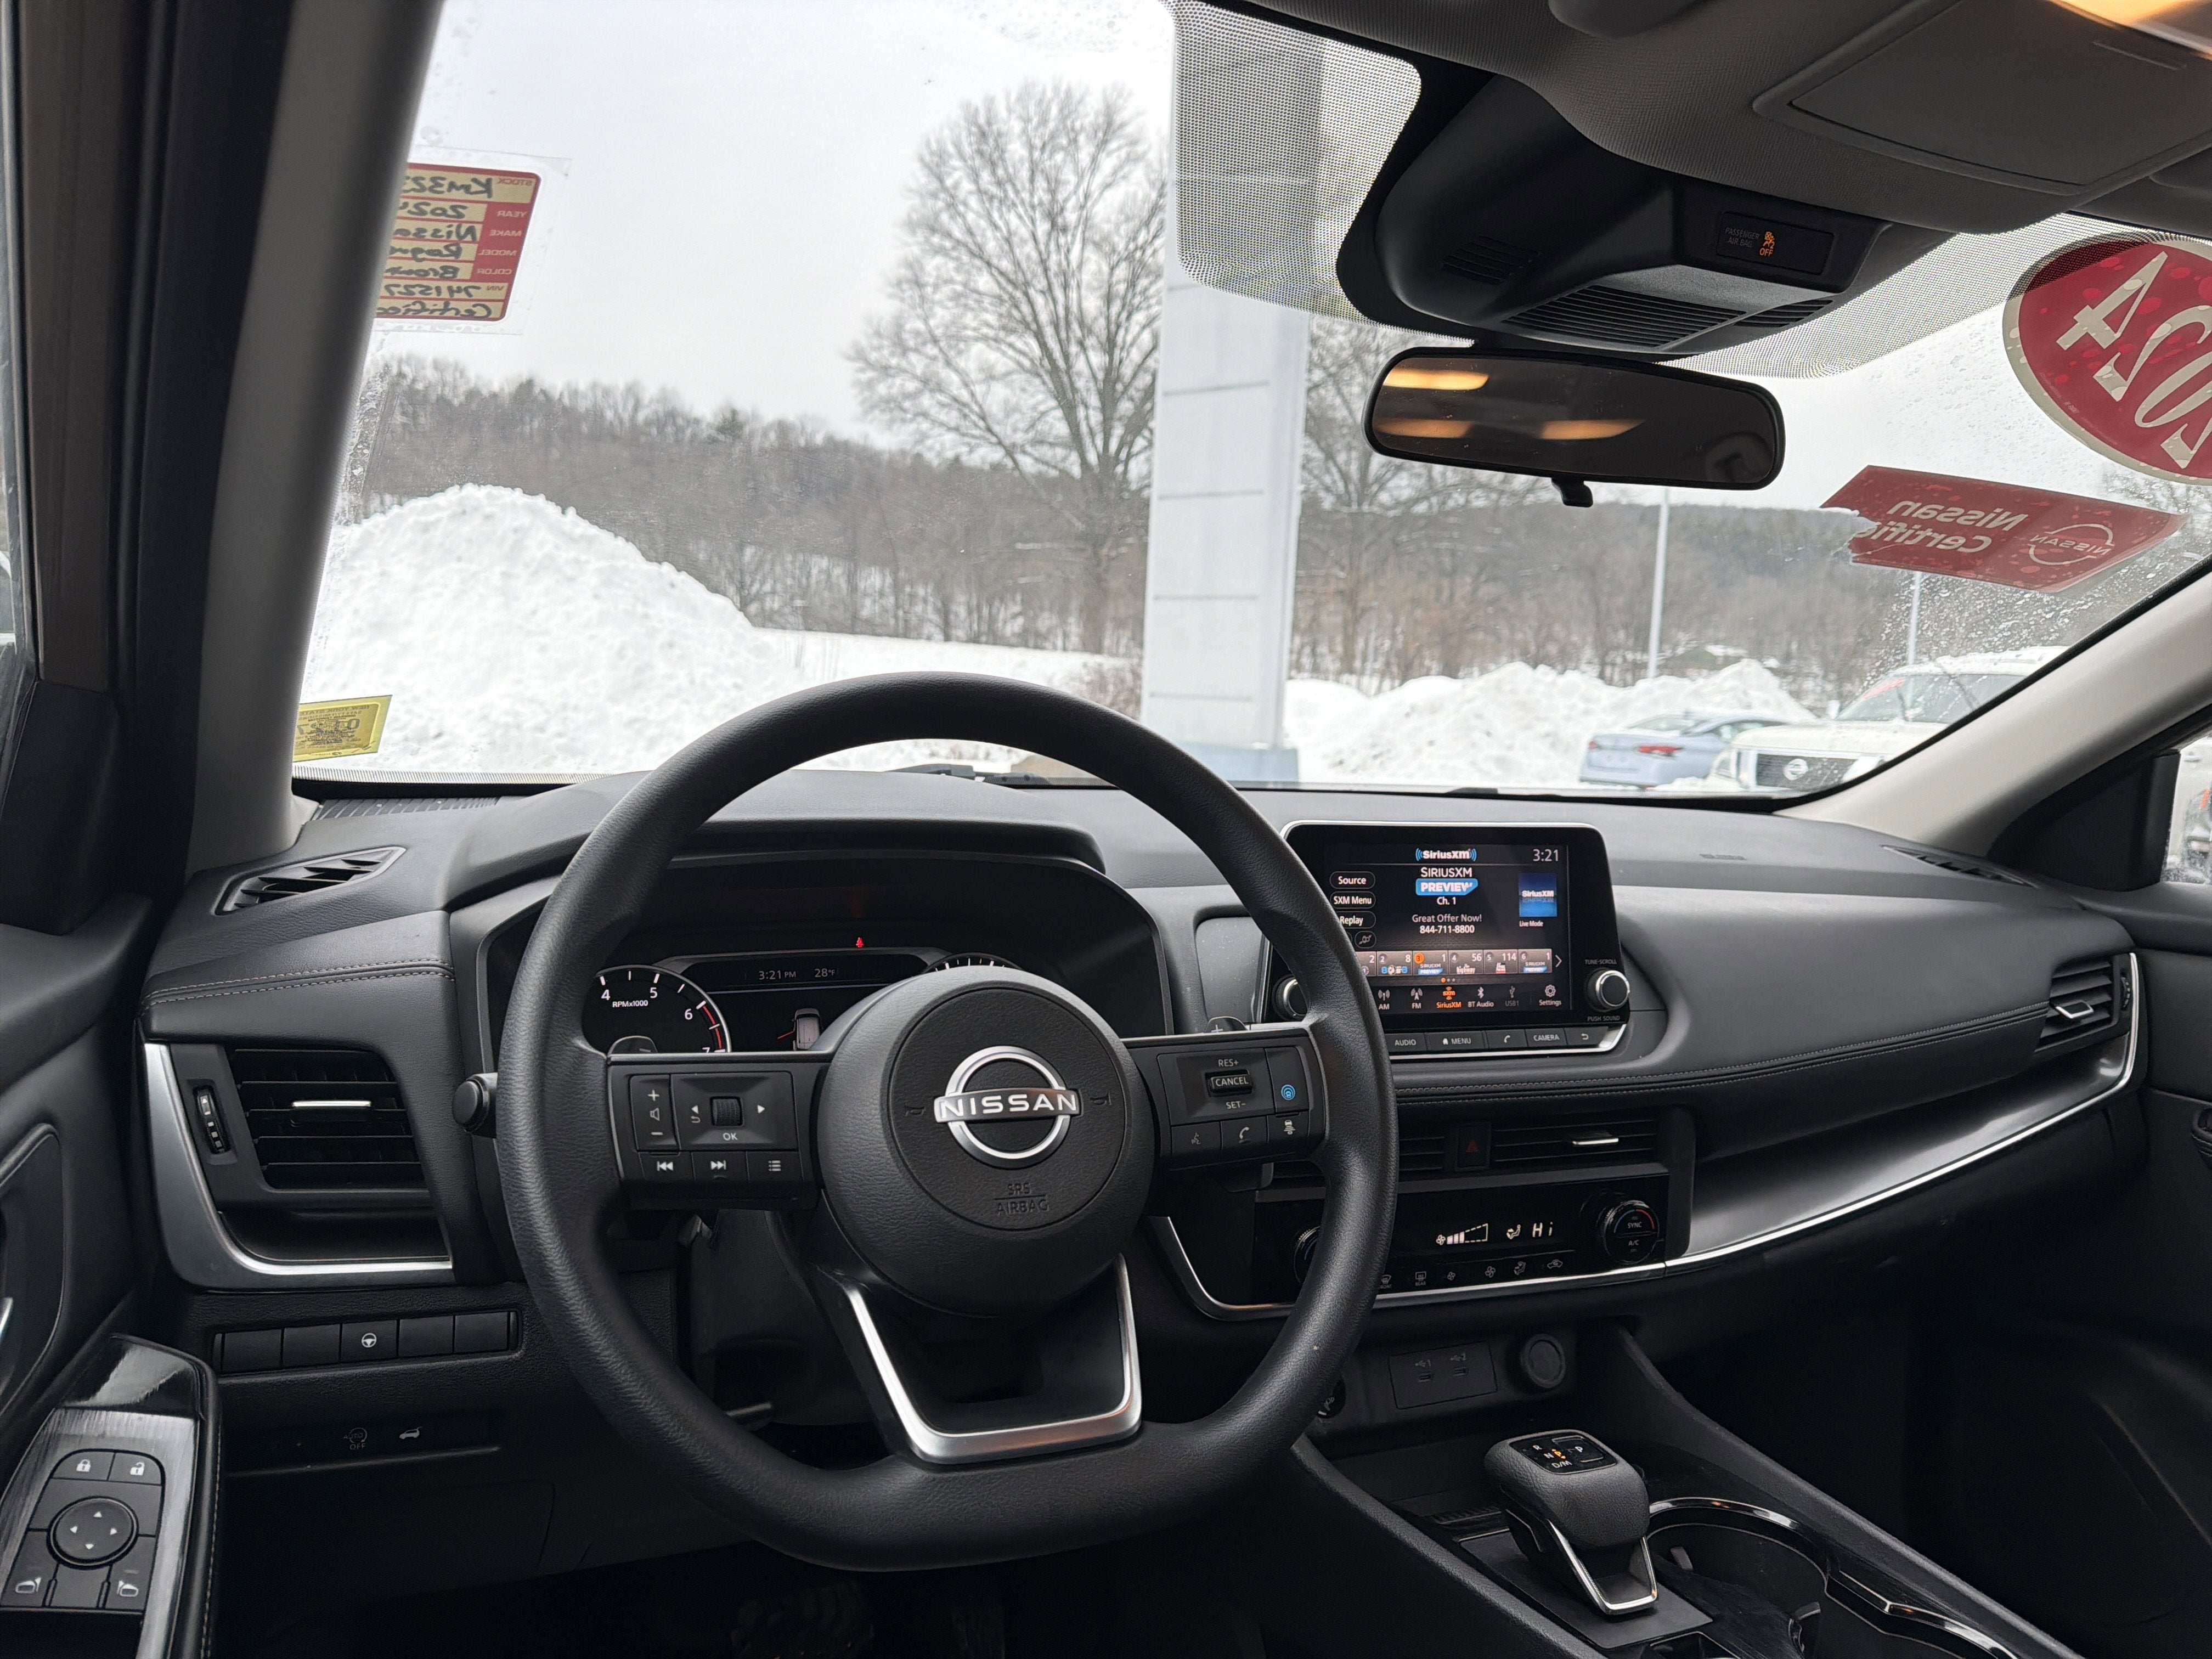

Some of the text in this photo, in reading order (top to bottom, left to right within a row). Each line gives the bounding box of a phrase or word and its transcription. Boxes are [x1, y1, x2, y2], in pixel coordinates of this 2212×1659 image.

[1725, 227, 1760, 240] PASSENGER
[1728, 237, 1754, 248] AIR BAG
[1759, 247, 1773, 257] OFF
[1532, 849, 1559, 862] 3:21
[1420, 867, 1472, 878] SIRIUSXM
[1338, 876, 1367, 885] Source
[1421, 882, 1473, 892] PREVIEW
[1333, 895, 1372, 904] SXM Menu
[1436, 896, 1457, 905] Ch. 1
[1340, 916, 1363, 926] Replay
[1412, 913, 1482, 923] Great Offer Now!
[1419, 925, 1475, 934] 844-711-8800
[1369, 955, 1375, 963] 2
[1405, 954, 1411, 963] 8
[1442, 953, 1446, 962] 1
[1471, 953, 1482, 962] 56
[1502, 952, 1517, 961] 114
[758, 969, 797, 981] 3:21 PM
[601, 989, 611, 1001] 4
[649, 988, 658, 999] 5
[612, 1000, 648, 1008] RPMx1000
[684, 1008, 693, 1020] 6
[1215, 1077, 1249, 1087] CANCEL
[939, 1093, 1077, 1119] NISSAN
[723, 1132, 738, 1142] OK
[1007, 1182, 1032, 1196] SRS
[995, 1199, 1049, 1216] AIRBAG
[1627, 1221, 1643, 1229] SYNC
[349, 1442, 366, 1451] OFF
[1551, 1460, 1573, 1469] D/M
